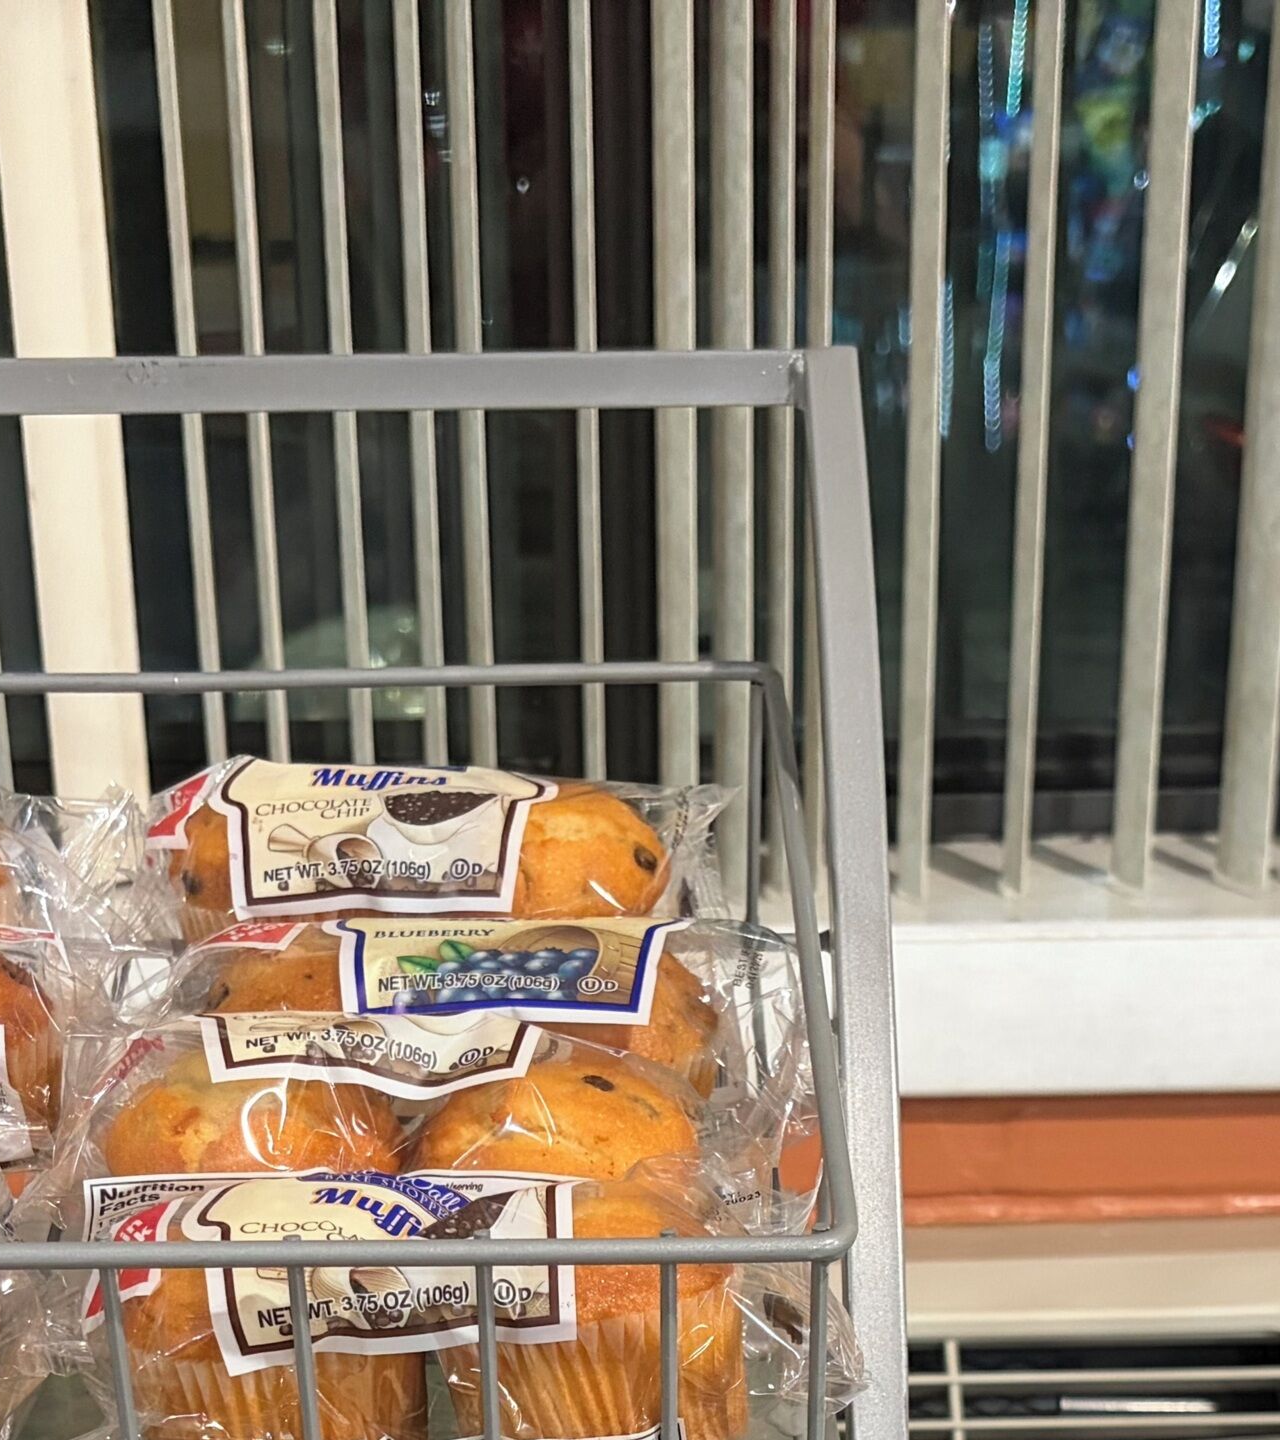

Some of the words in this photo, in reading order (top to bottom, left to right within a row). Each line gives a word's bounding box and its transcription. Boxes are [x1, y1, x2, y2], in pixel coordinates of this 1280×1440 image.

[311, 768, 449, 791] Muffins
[255, 798, 372, 817] CHOCOLATE
[319, 805, 371, 820] CHIP
[263, 867, 292, 883] NET
[294, 862, 326, 879] WT.
[327, 860, 359, 876] 3.75
[360, 859, 384, 875] OZ
[385, 859, 432, 880] (106g)
[373, 928, 497, 939] BLUEBERRY
[378, 977, 409, 993] NET
[413, 974, 442, 992] WT.
[444, 974, 478, 989] 3.75
[482, 974, 508, 987] OZ
[508, 974, 560, 992] (106g)
[245, 1033, 281, 1050] NET
[321, 1030, 356, 1047] 3.75
[360, 1032, 385, 1051] OZ
[388, 1037, 438, 1070] (106g)
[99, 1182, 205, 1203] Nutrition
[382, 1178, 449, 1219] SHOPPE
[99, 1193, 161, 1216] Facts
[342, 1295, 379, 1315] 3.75
[383, 1291, 411, 1311] OZ
[416, 1282, 470, 1311] (106g)
